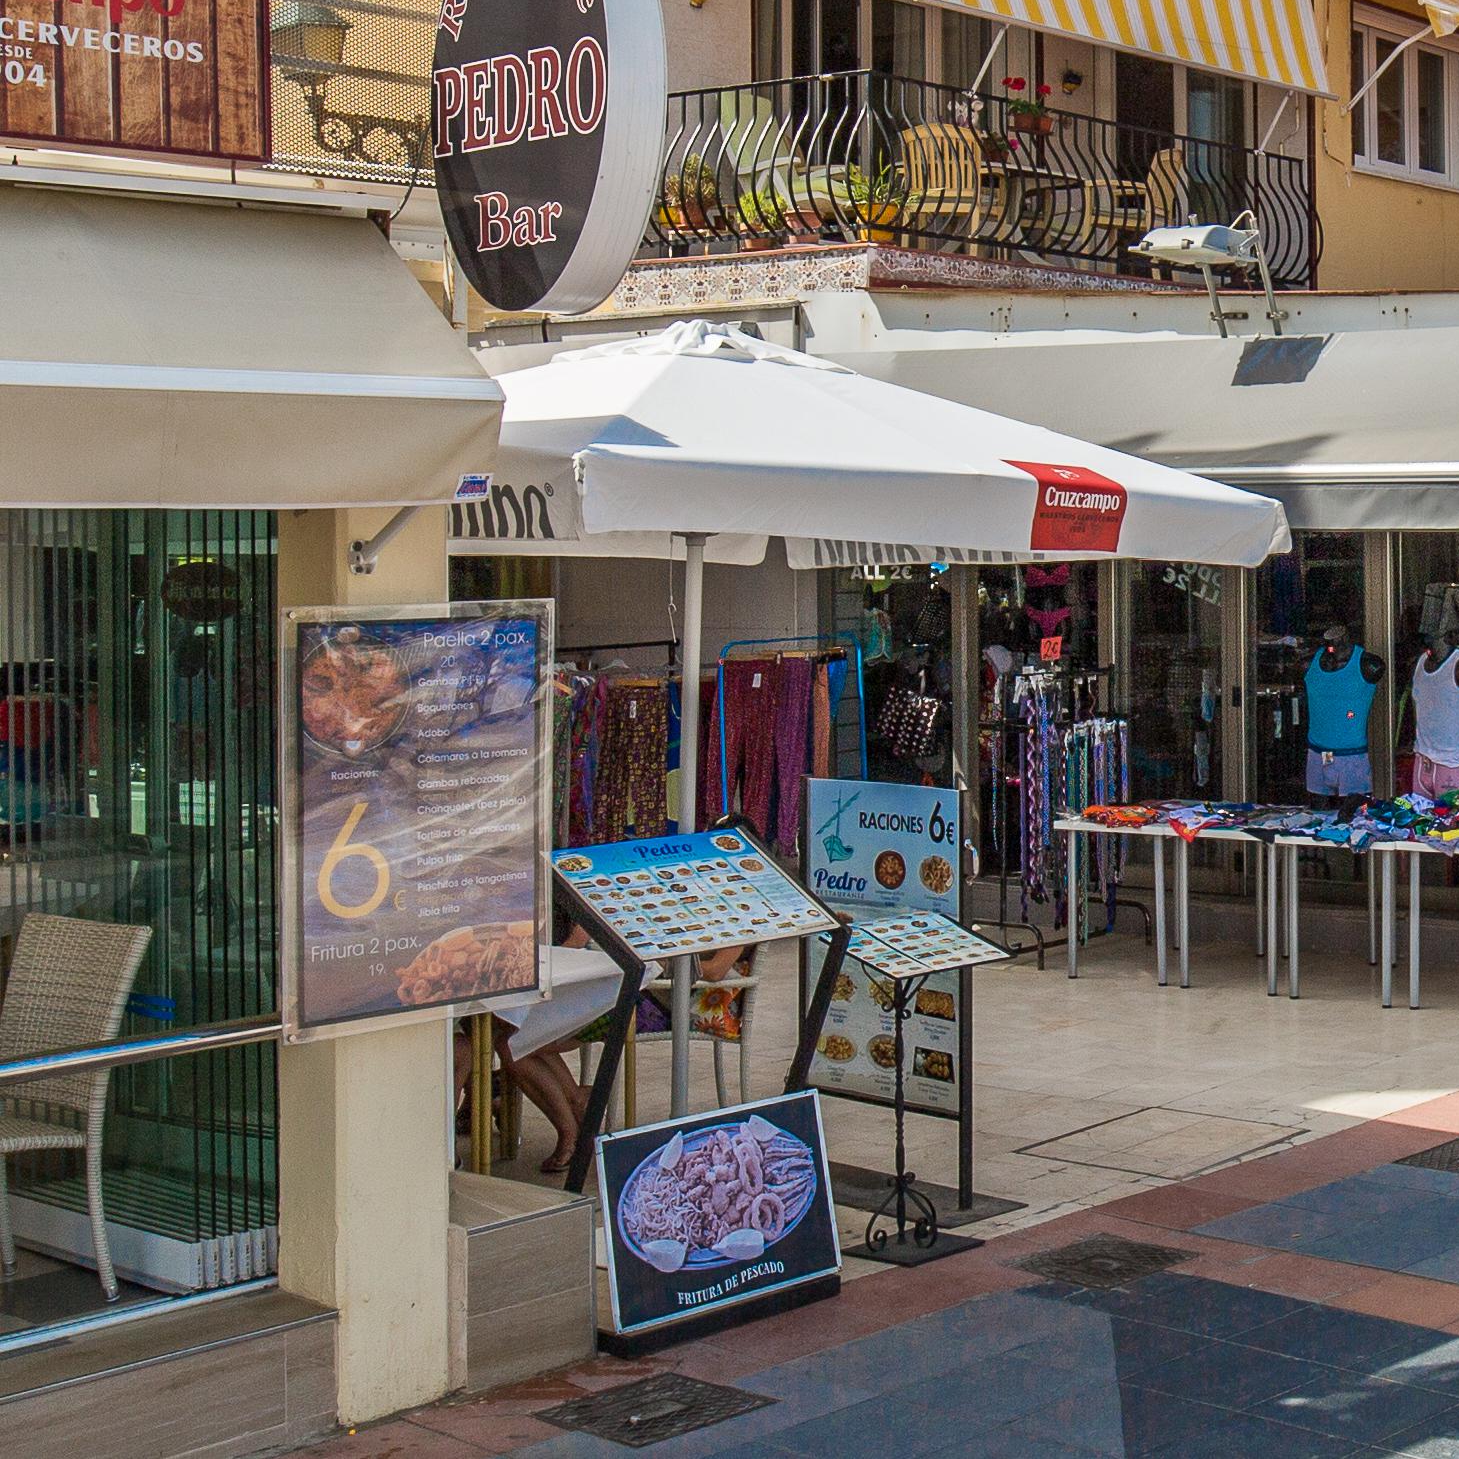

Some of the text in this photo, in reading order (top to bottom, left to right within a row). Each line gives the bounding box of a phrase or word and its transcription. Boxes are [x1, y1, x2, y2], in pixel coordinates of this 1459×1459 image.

[0, 17, 204, 63] CERVECEROS
[433, 35, 607, 159] PEDRO
[474, 191, 563, 253] Bar
[1045, 486, 1120, 513] Cruzcampo
[850, 564, 913, 581] ALL 2€
[423, 629, 530, 648] Paella 2 pax.
[417, 728, 451, 738] Adobo
[417, 751, 470, 764] Calamares
[480, 750, 490, 759] la
[491, 748, 528, 758] romana
[417, 773, 510, 790] Gambas rebozadas
[417, 801, 475, 815] Chanquetes
[859, 811, 923, 834] RACIONES
[417, 823, 521, 841] Tortillas de camarones
[416, 852, 464, 866] Pulpo frito
[633, 843, 692, 859] Pedro
[417, 879, 459, 893] Pinchitos
[461, 877, 474, 887] de
[814, 868, 868, 892] Pedro
[418, 904, 461, 918] Jibia frita
[311, 935, 423, 963] Fritura 2 pax.
[677, 1261, 785, 1305] FRITURA DE PESCADO
